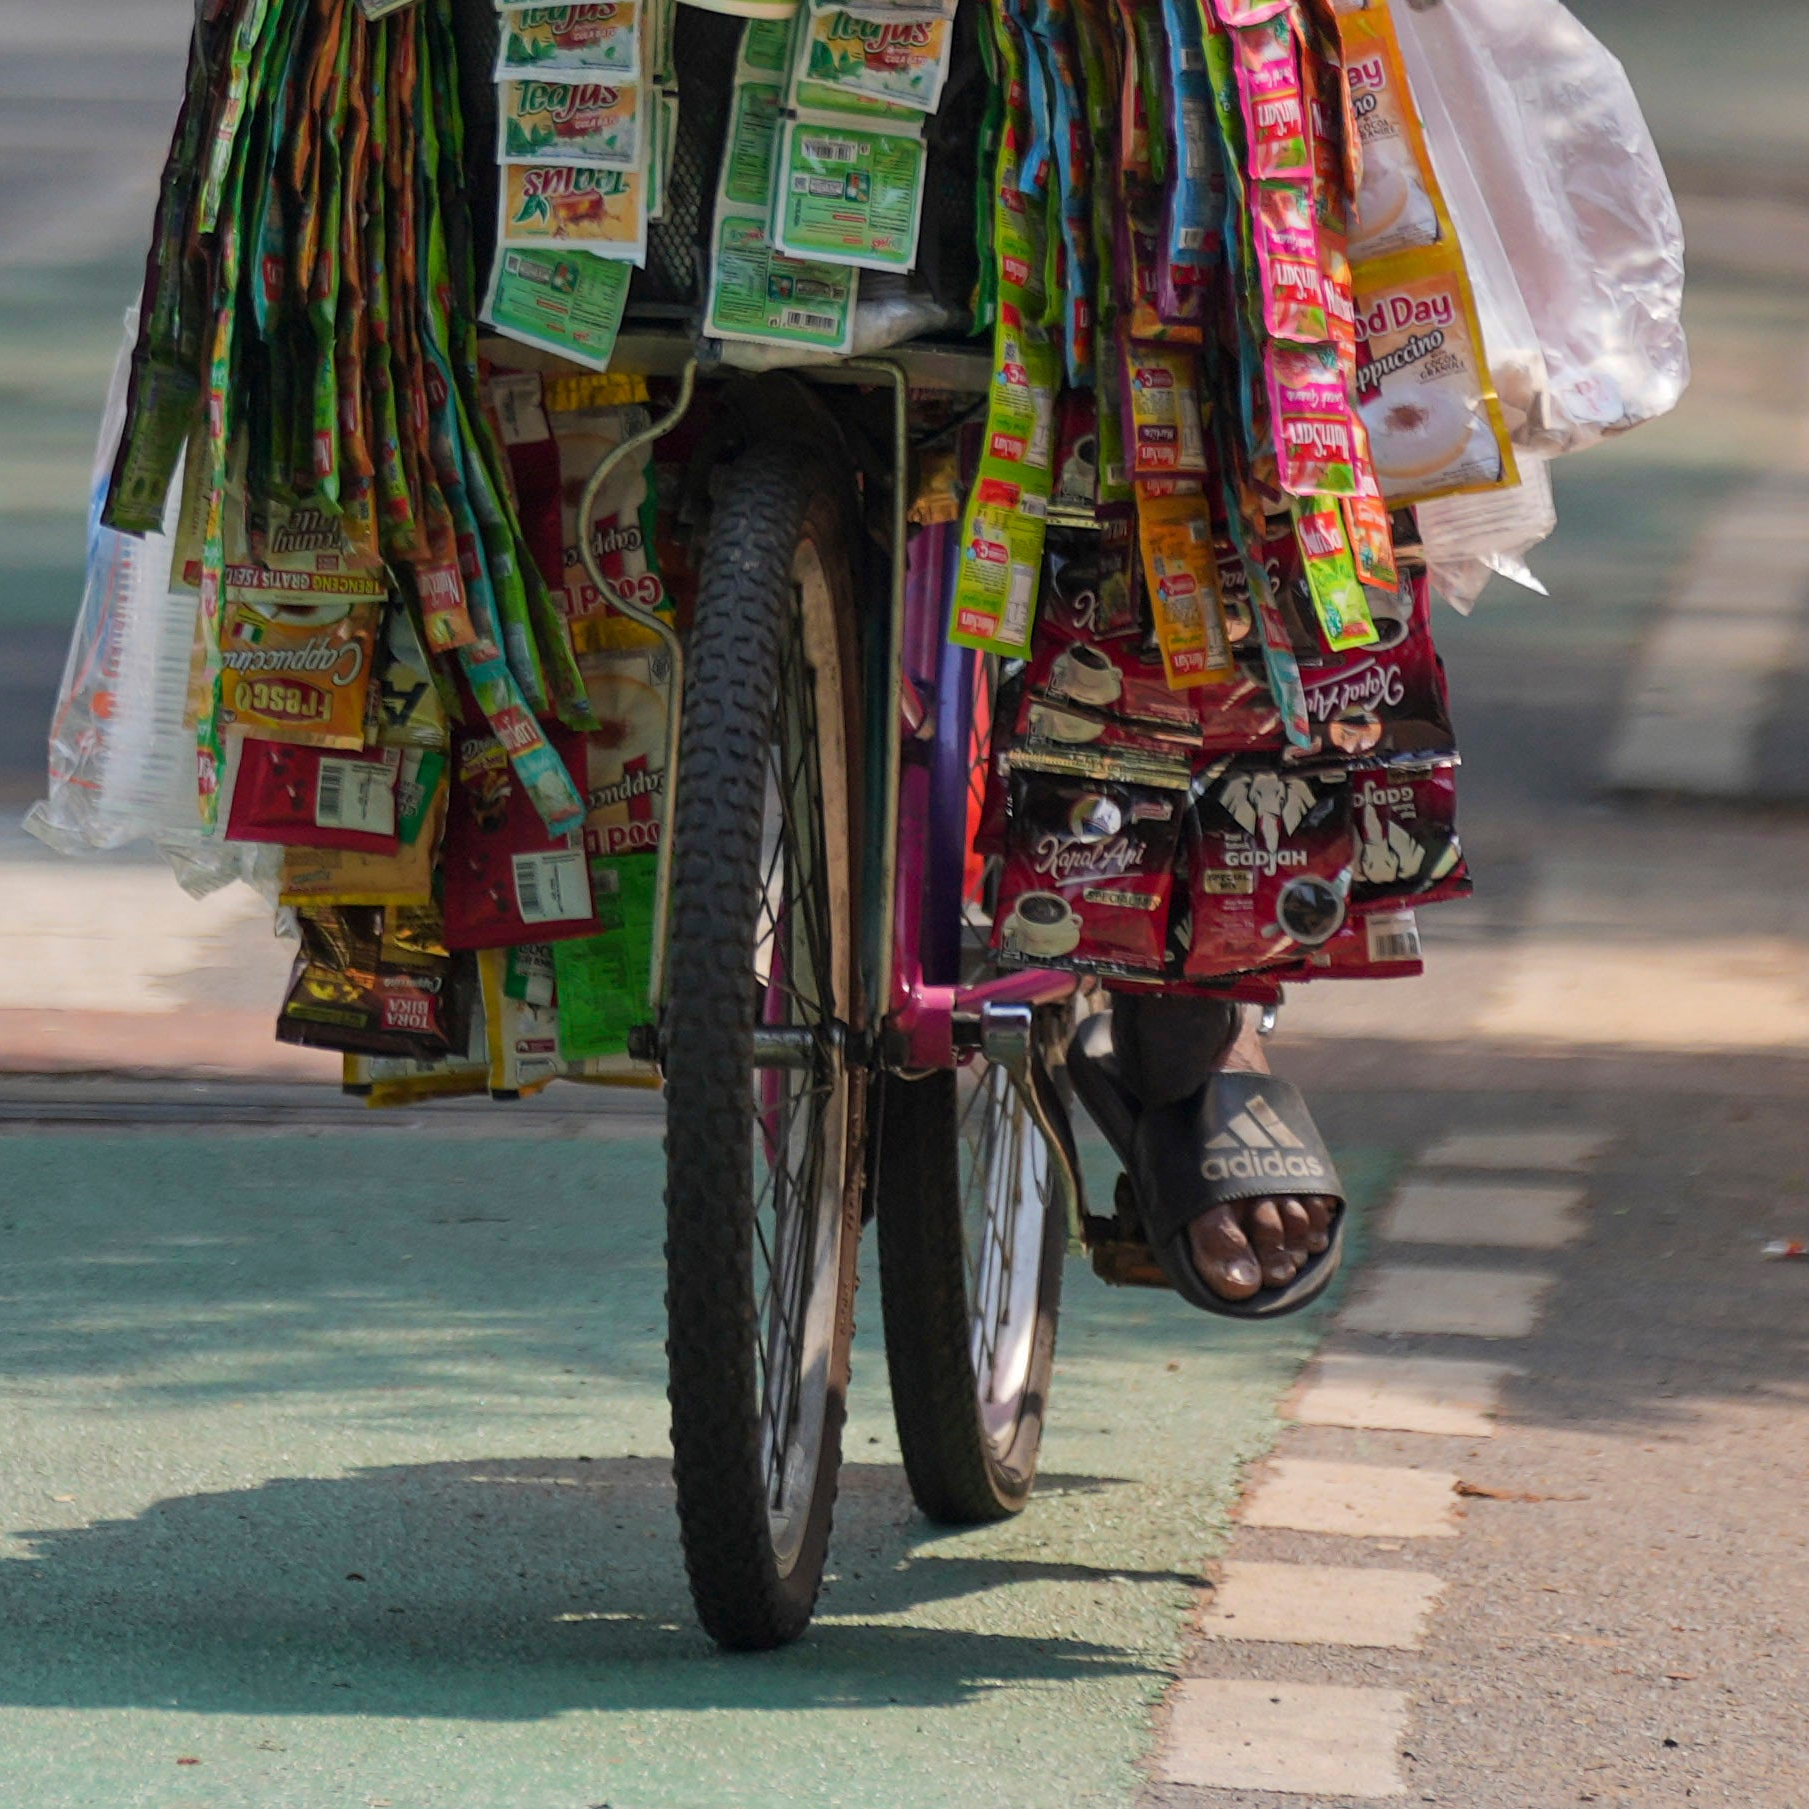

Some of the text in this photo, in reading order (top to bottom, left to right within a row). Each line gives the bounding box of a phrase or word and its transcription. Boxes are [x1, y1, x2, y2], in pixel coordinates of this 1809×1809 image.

[1347, 58, 1384, 89] ay
[1355, 294, 1453, 339] od Day
[1357, 330, 1443, 392] ppuccino
[261, 572, 311, 590] GRATIS
[234, 682, 333, 723] Fresco
[611, 821, 661, 851] ood
[1034, 833, 1148, 880] Kapal Api
[386, 1012, 430, 1029] TORA
[388, 999, 429, 1013] BIKA
[1201, 1149, 1326, 1182] adidas
